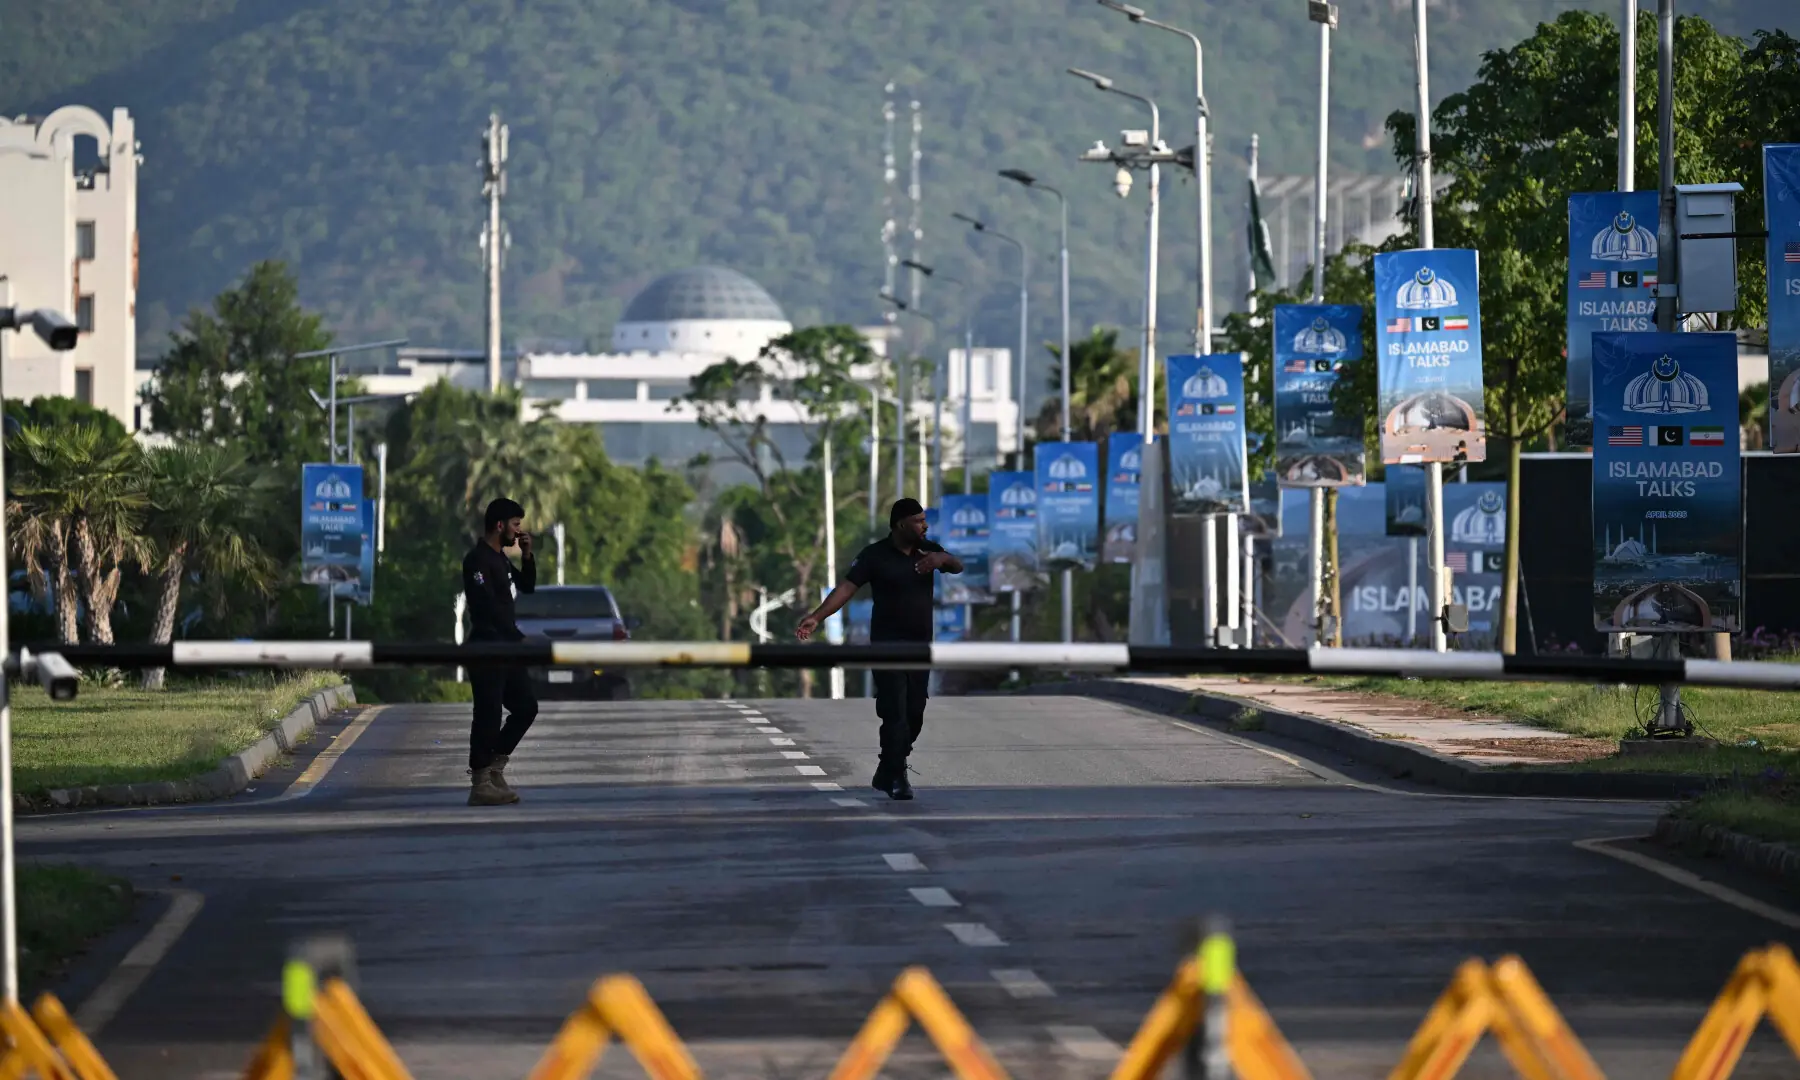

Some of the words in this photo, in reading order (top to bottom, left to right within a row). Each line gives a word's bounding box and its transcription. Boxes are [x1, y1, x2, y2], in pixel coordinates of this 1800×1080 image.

[1579, 301, 1657, 316] ISLAMABA
[1600, 317, 1648, 332] TALKS
[1388, 340, 1469, 356] ISLAMABAD
[1408, 354, 1451, 368] TALKS
[1608, 461, 1724, 478] ISLAMABAD
[1636, 481, 1696, 497] TALKS
[1645, 510, 1668, 519] APRIL
